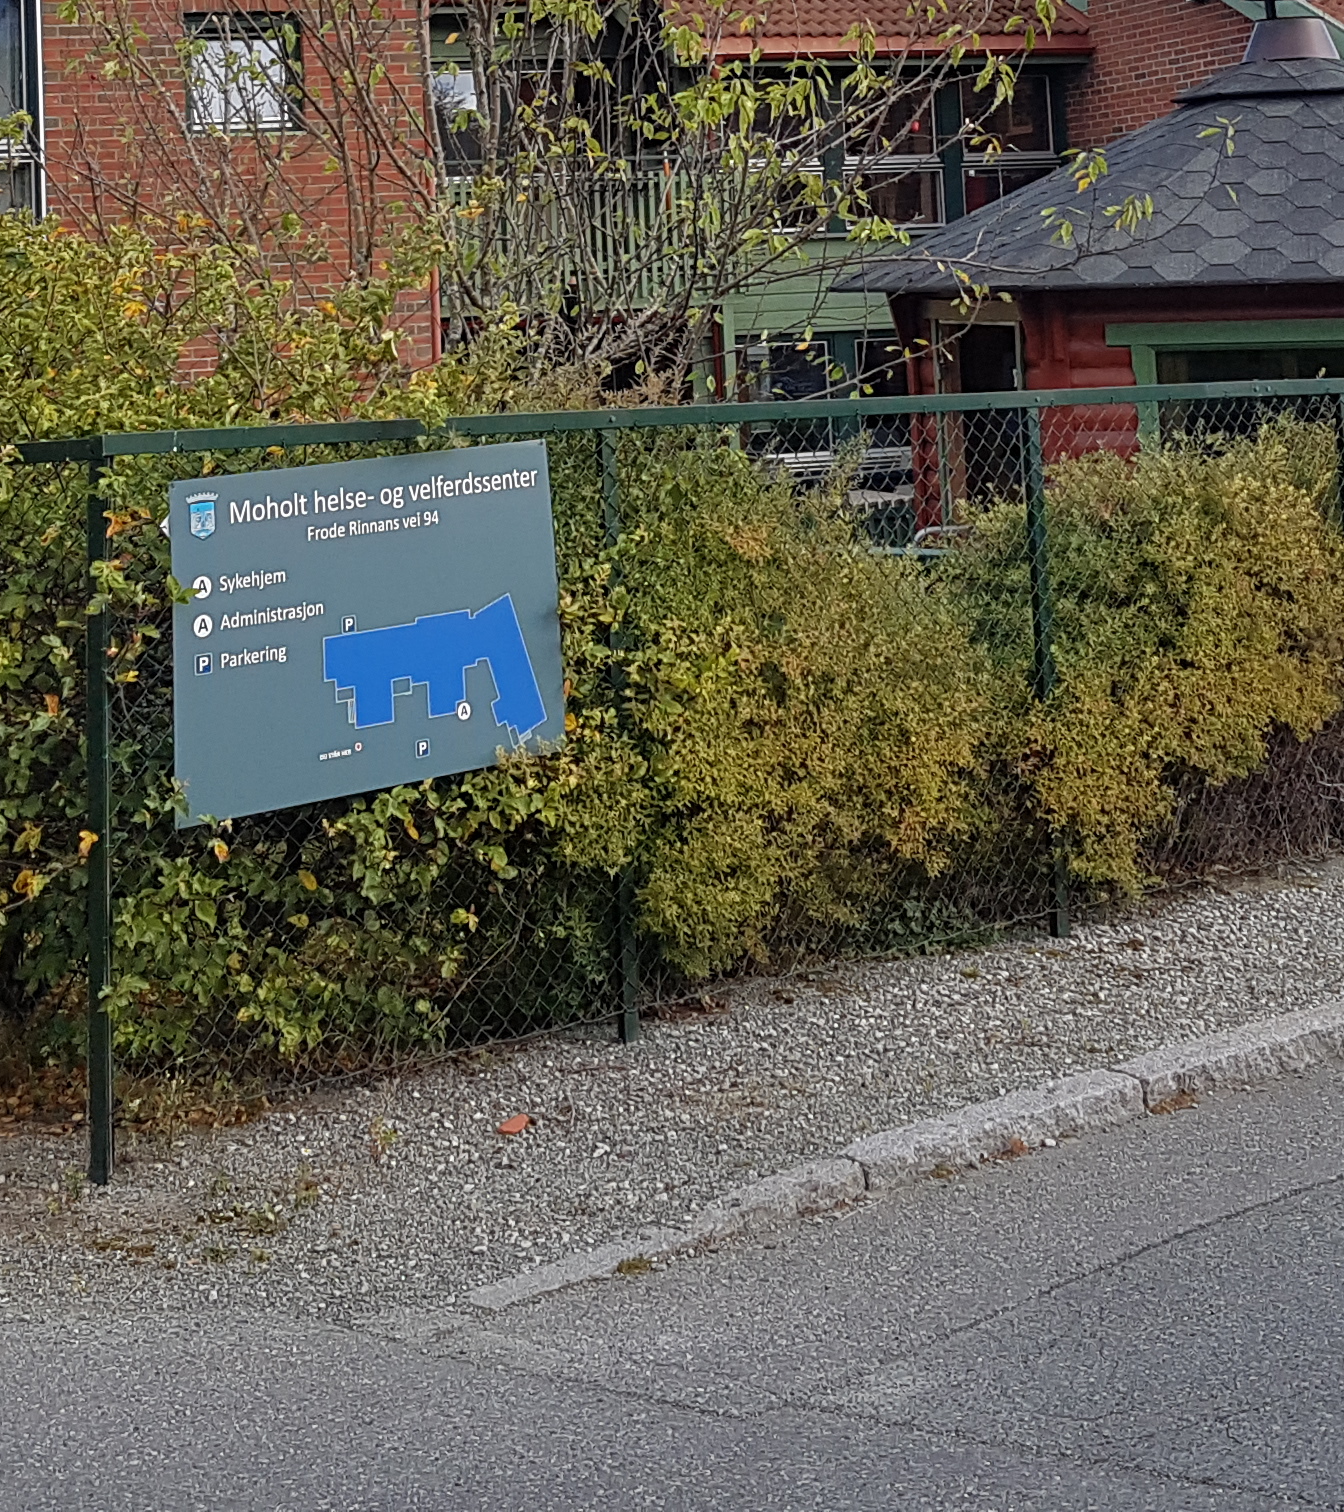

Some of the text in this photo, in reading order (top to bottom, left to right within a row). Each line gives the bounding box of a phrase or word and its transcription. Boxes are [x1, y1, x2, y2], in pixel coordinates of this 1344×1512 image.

[229, 468, 538, 524] Moholt helse- og velferdssenter
[307, 510, 439, 542] Frode Rinnans vei 94
[219, 570, 287, 594] Sykehjem
[197, 601, 324, 634] A Administrasjon
[220, 645, 287, 669] Parkering
